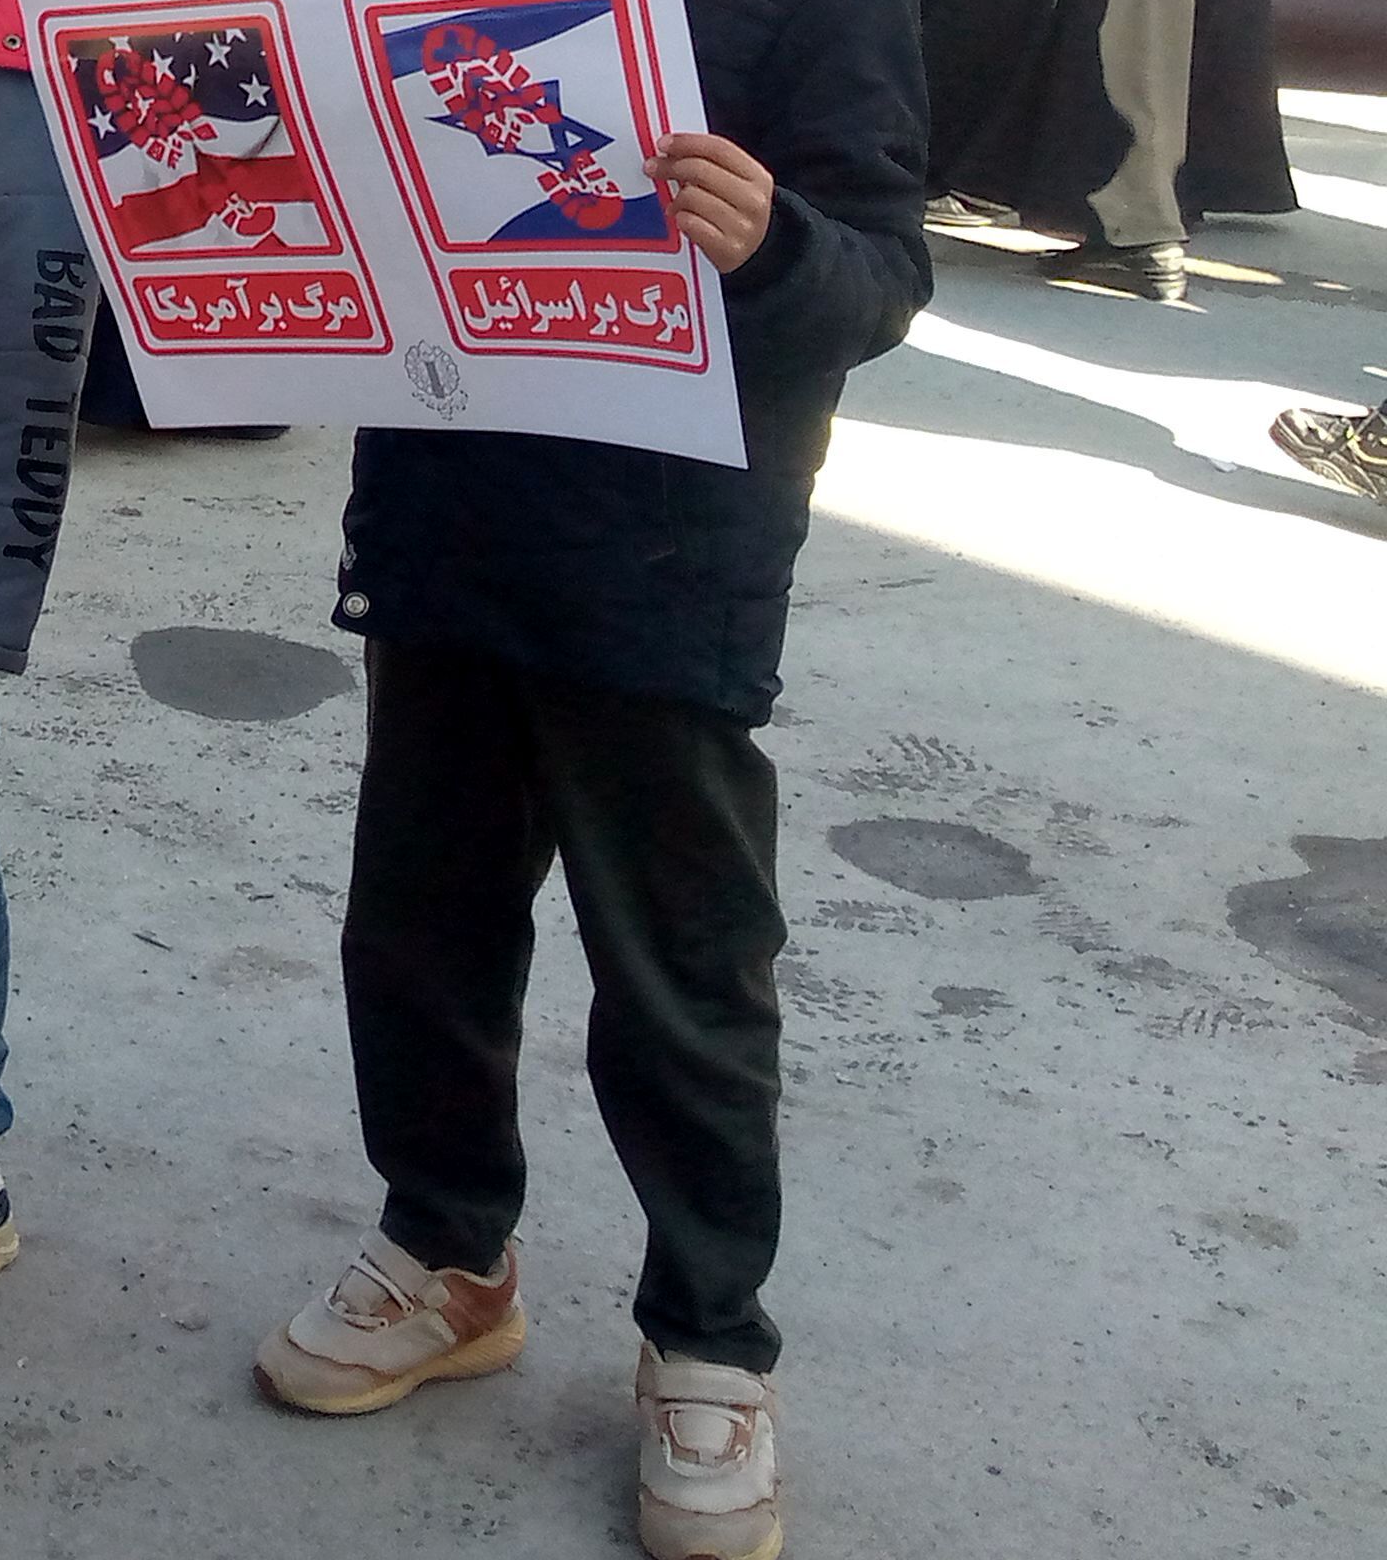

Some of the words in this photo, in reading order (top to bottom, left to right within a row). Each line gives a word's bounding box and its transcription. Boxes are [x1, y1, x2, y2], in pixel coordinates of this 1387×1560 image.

[31, 249, 87, 363] BAD
[145, 278, 251, 333] آمریکا
[258, 293, 288, 331] بر
[288, 281, 359, 331] مرگ
[464, 276, 587, 332] اسرائیل
[589, 293, 620, 336] بر
[624, 284, 689, 343] مرگ
[2, 391, 77, 571] TEDDY
